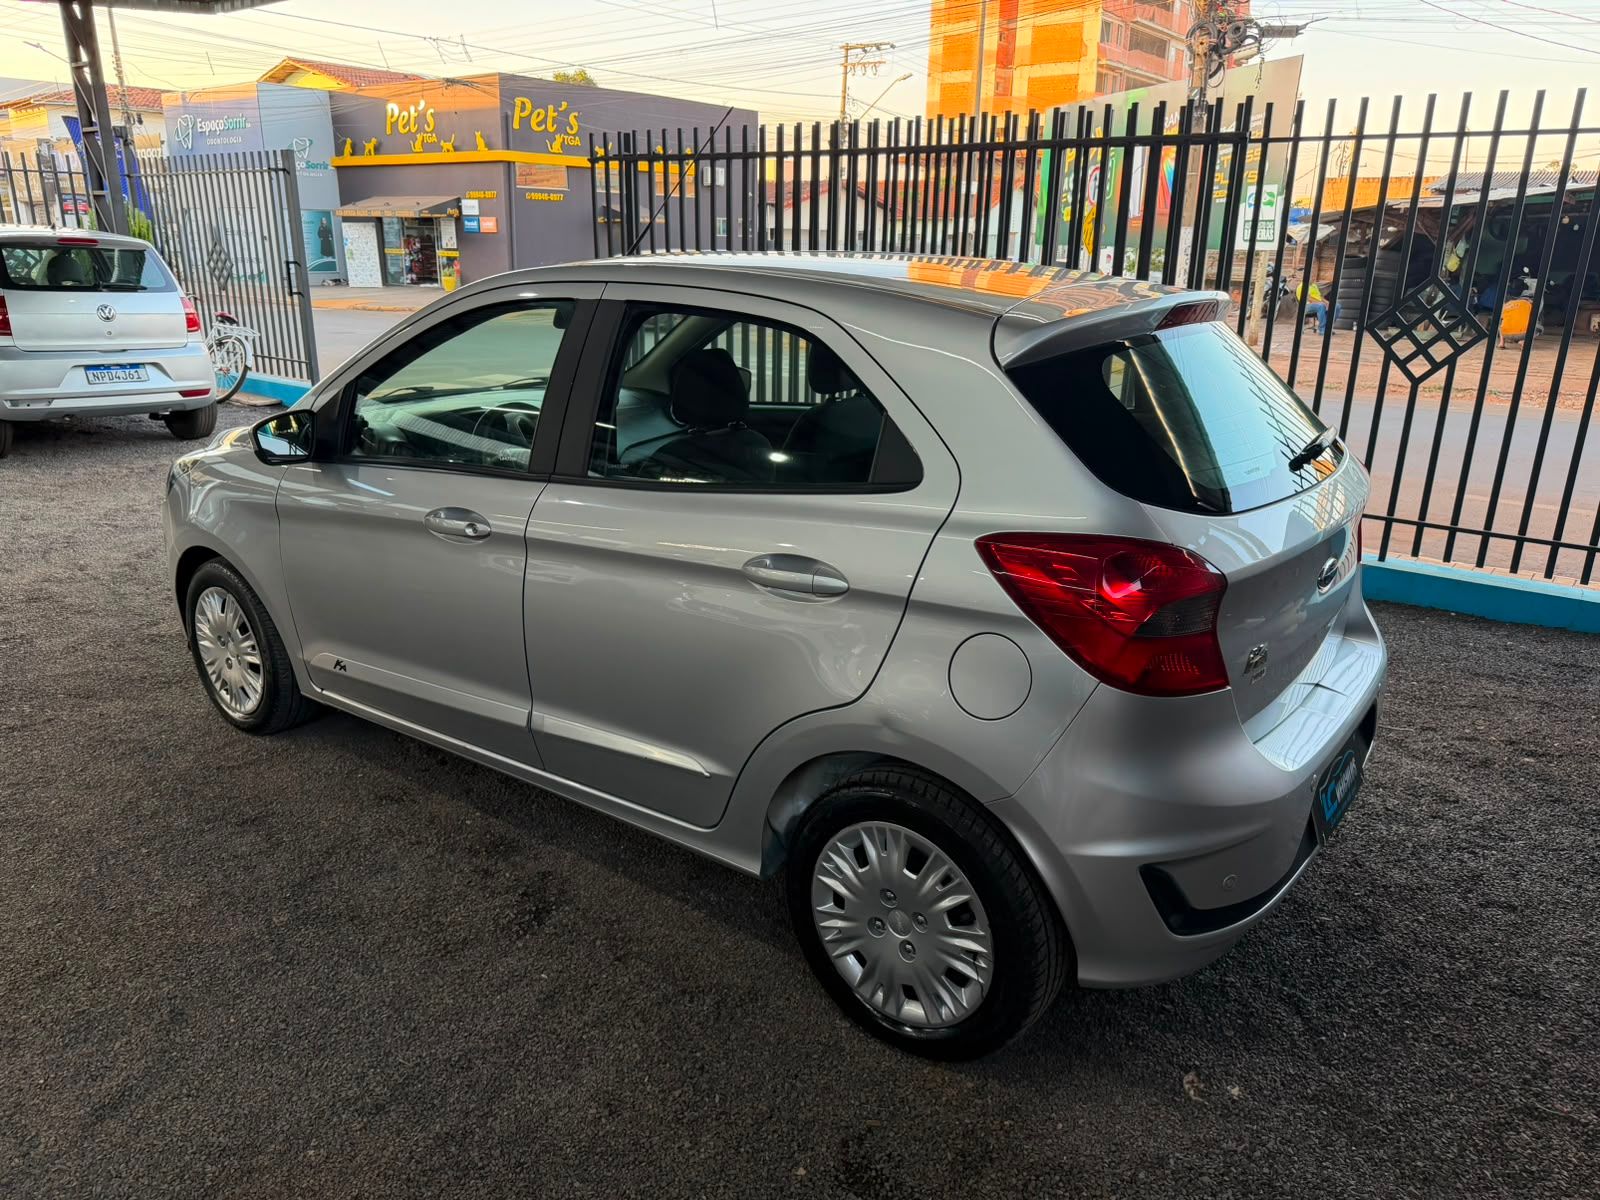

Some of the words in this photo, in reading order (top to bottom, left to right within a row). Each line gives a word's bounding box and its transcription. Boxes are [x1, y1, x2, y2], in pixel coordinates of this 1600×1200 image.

[386, 99, 435, 135] Pet's
[512, 96, 579, 134] Pet's
[206, 136, 242, 145] ODONTOLOGIA
[423, 133, 438, 143] TGA
[563, 135, 581, 146] TGA
[92, 370, 142, 382] NPD4J61
